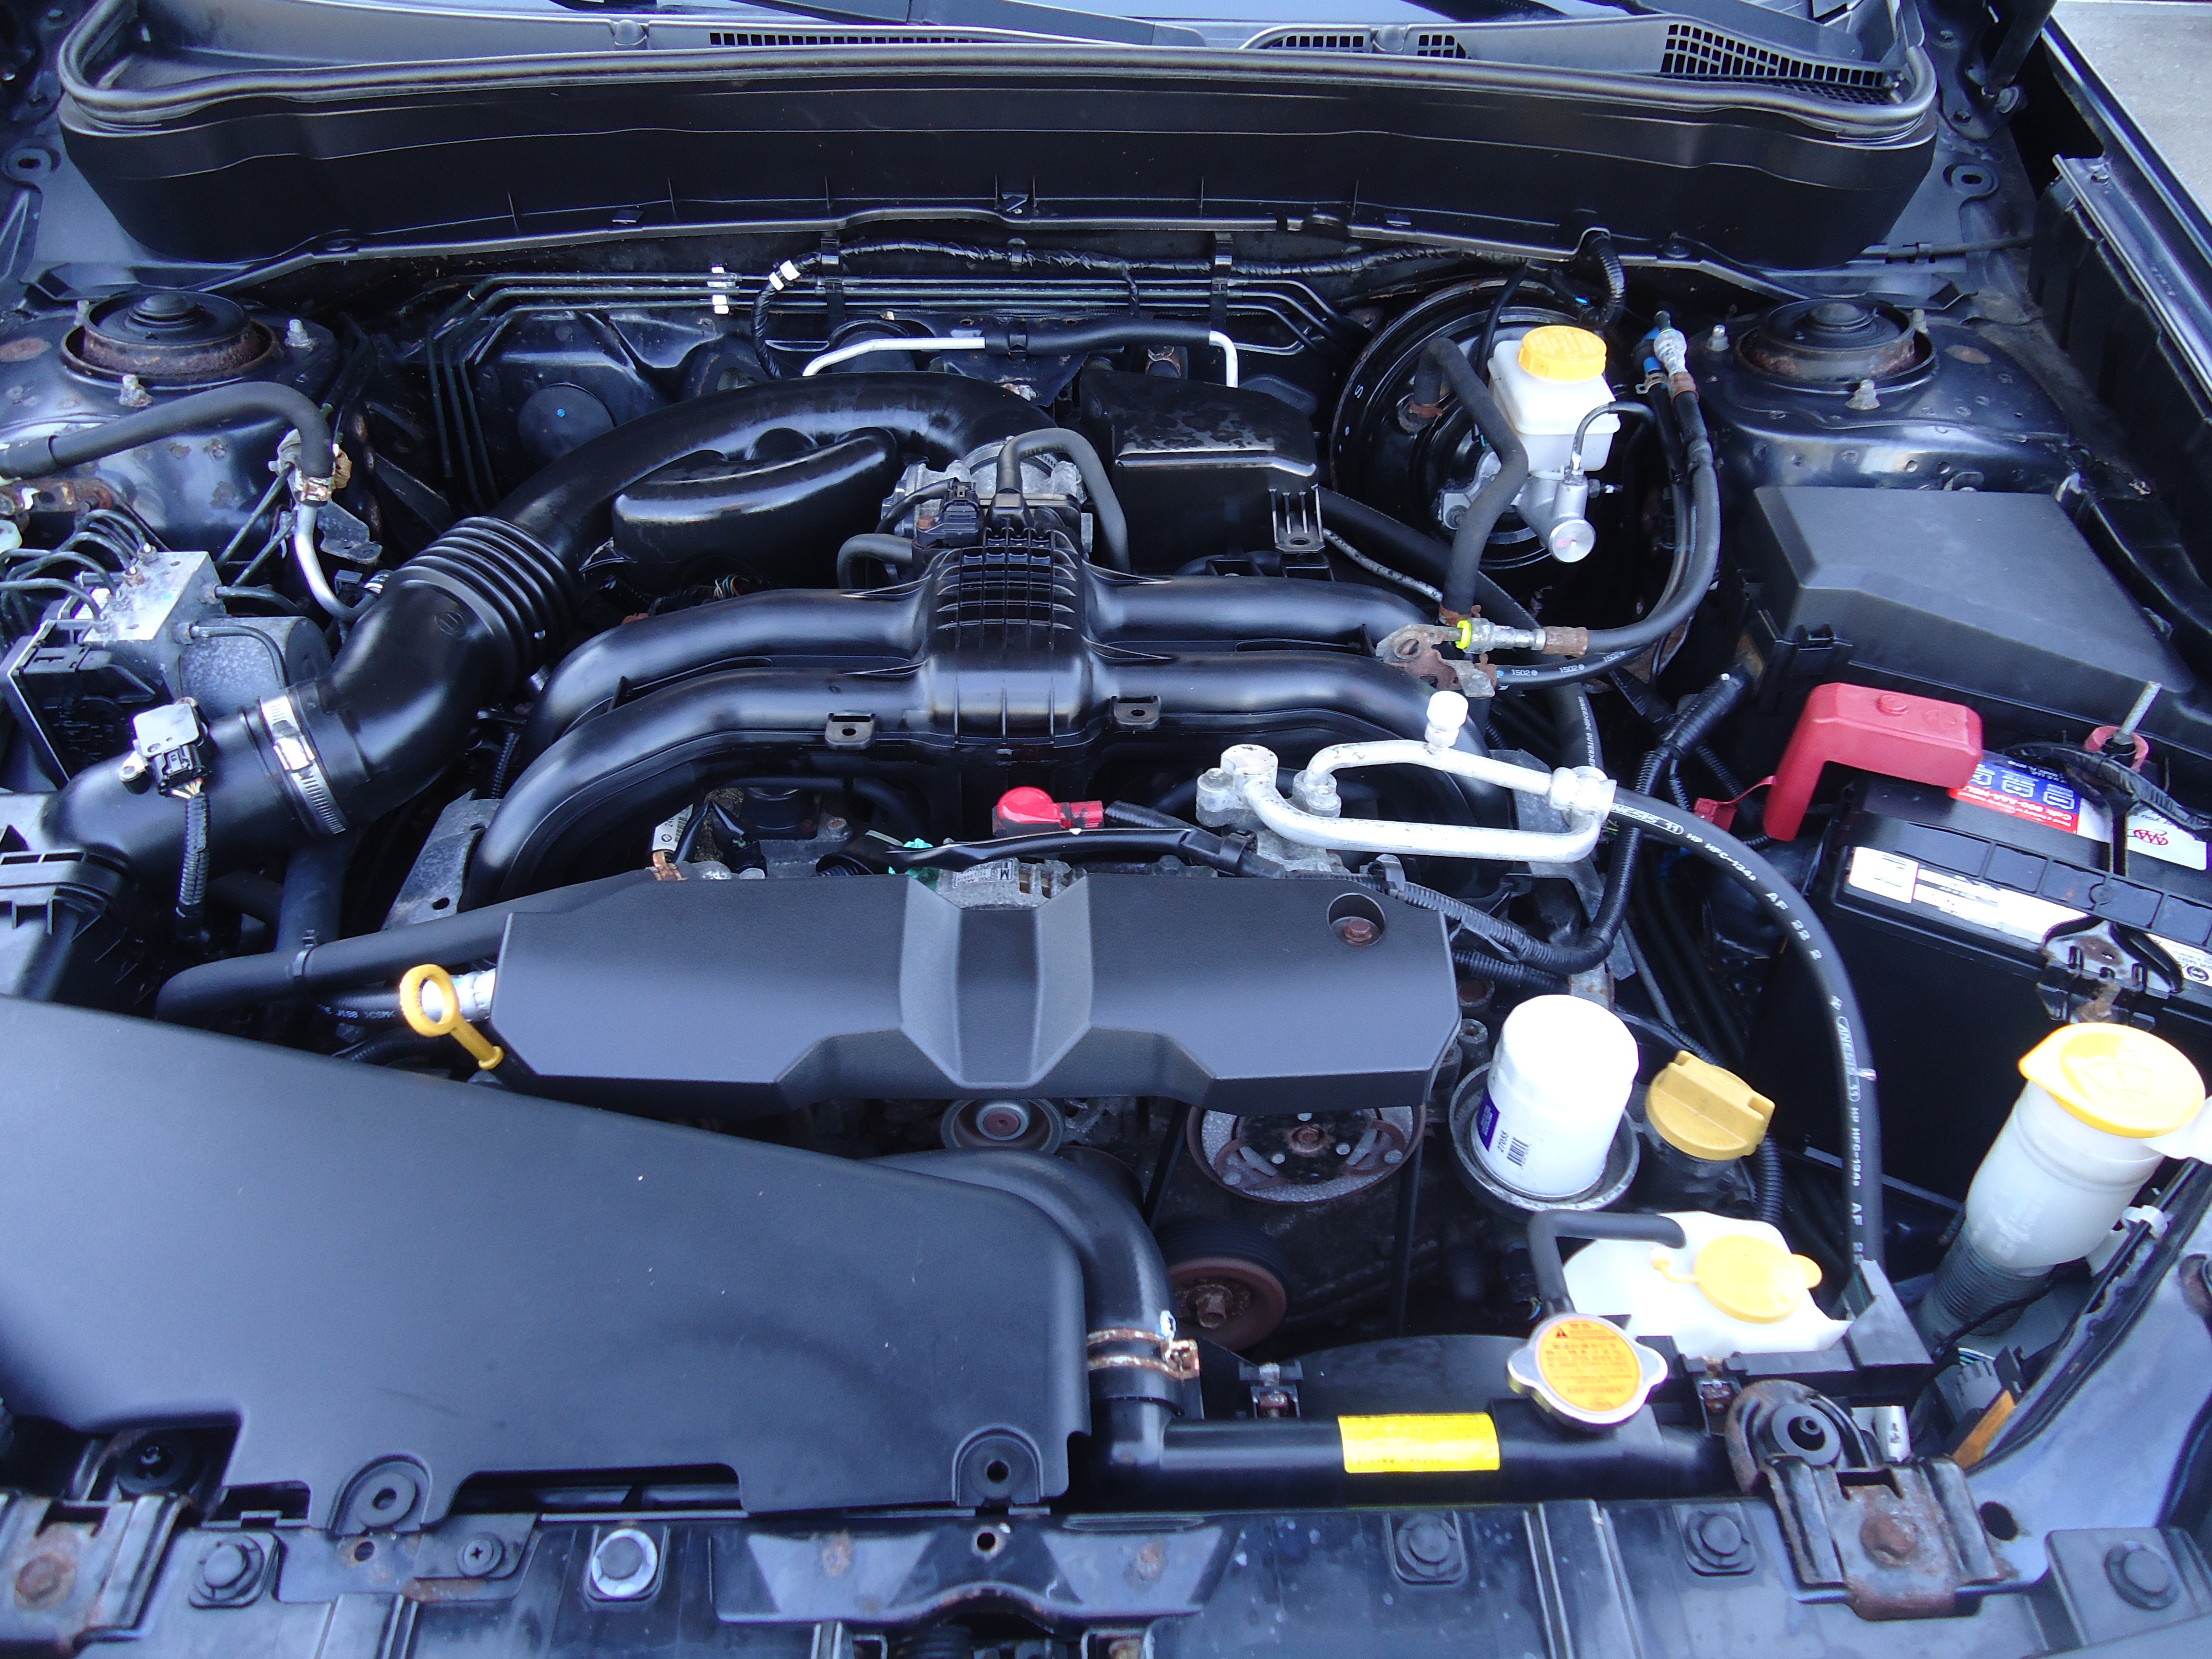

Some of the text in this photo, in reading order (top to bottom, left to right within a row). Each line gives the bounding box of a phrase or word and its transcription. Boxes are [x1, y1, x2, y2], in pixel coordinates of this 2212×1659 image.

[1602, 652, 1620, 663] 1502
[1511, 668, 1530, 677] 1502
[1558, 665, 1578, 673] 1502
[1962, 783, 2044, 812] 800-AAA-HEL
[1612, 804, 1657, 823] NESIS
[1665, 822, 1679, 833] 11
[1686, 833, 1704, 843] HP
[1765, 892, 1789, 910] AF
[1791, 919, 1811, 941] 22
[1497, 1130, 1509, 1153] 27055
